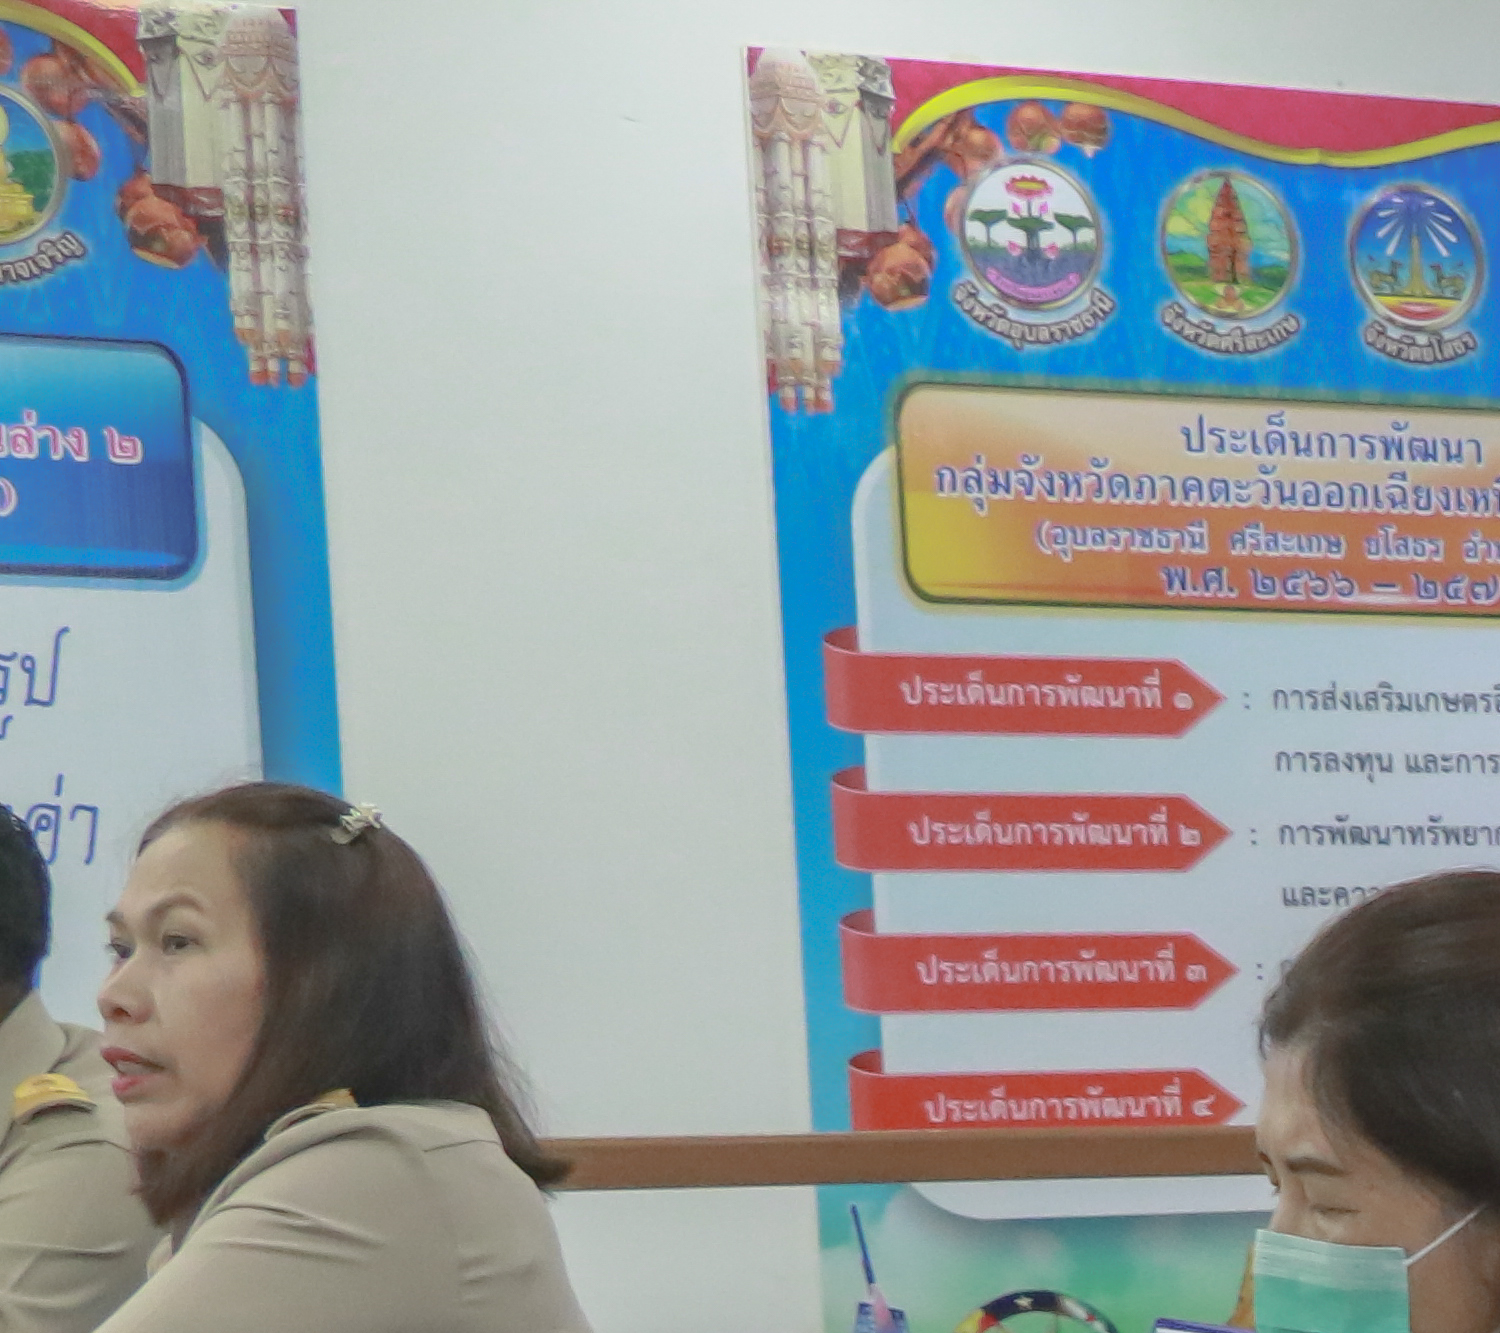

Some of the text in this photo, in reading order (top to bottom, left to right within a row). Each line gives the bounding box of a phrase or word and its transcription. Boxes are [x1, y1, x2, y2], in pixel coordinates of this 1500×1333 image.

[103, 425, 144, 465] ๒
[1181, 411, 1484, 465] ประเด็นการพัฒนา
[1037, 519, 1208, 562] (อุบลราชธานี
[1230, 521, 1346, 559] ศรีสะเกษ
[1366, 525, 1444, 562] ยโสธร
[1160, 566, 1238, 598] พ.ศ.
[1250, 566, 1356, 600] ๒๕๖๖
[900, 668, 1162, 708] ประเด็นการพัฒนาที่
[1276, 748, 1393, 783] การลงทุน
[908, 805, 1203, 847] ประเด็นการพัฒนาที่ ๒
[916, 943, 1176, 986] ประเด็นการพัฒนาที่
[925, 1077, 1182, 1124] ประเด็นการพัฒนาที่
